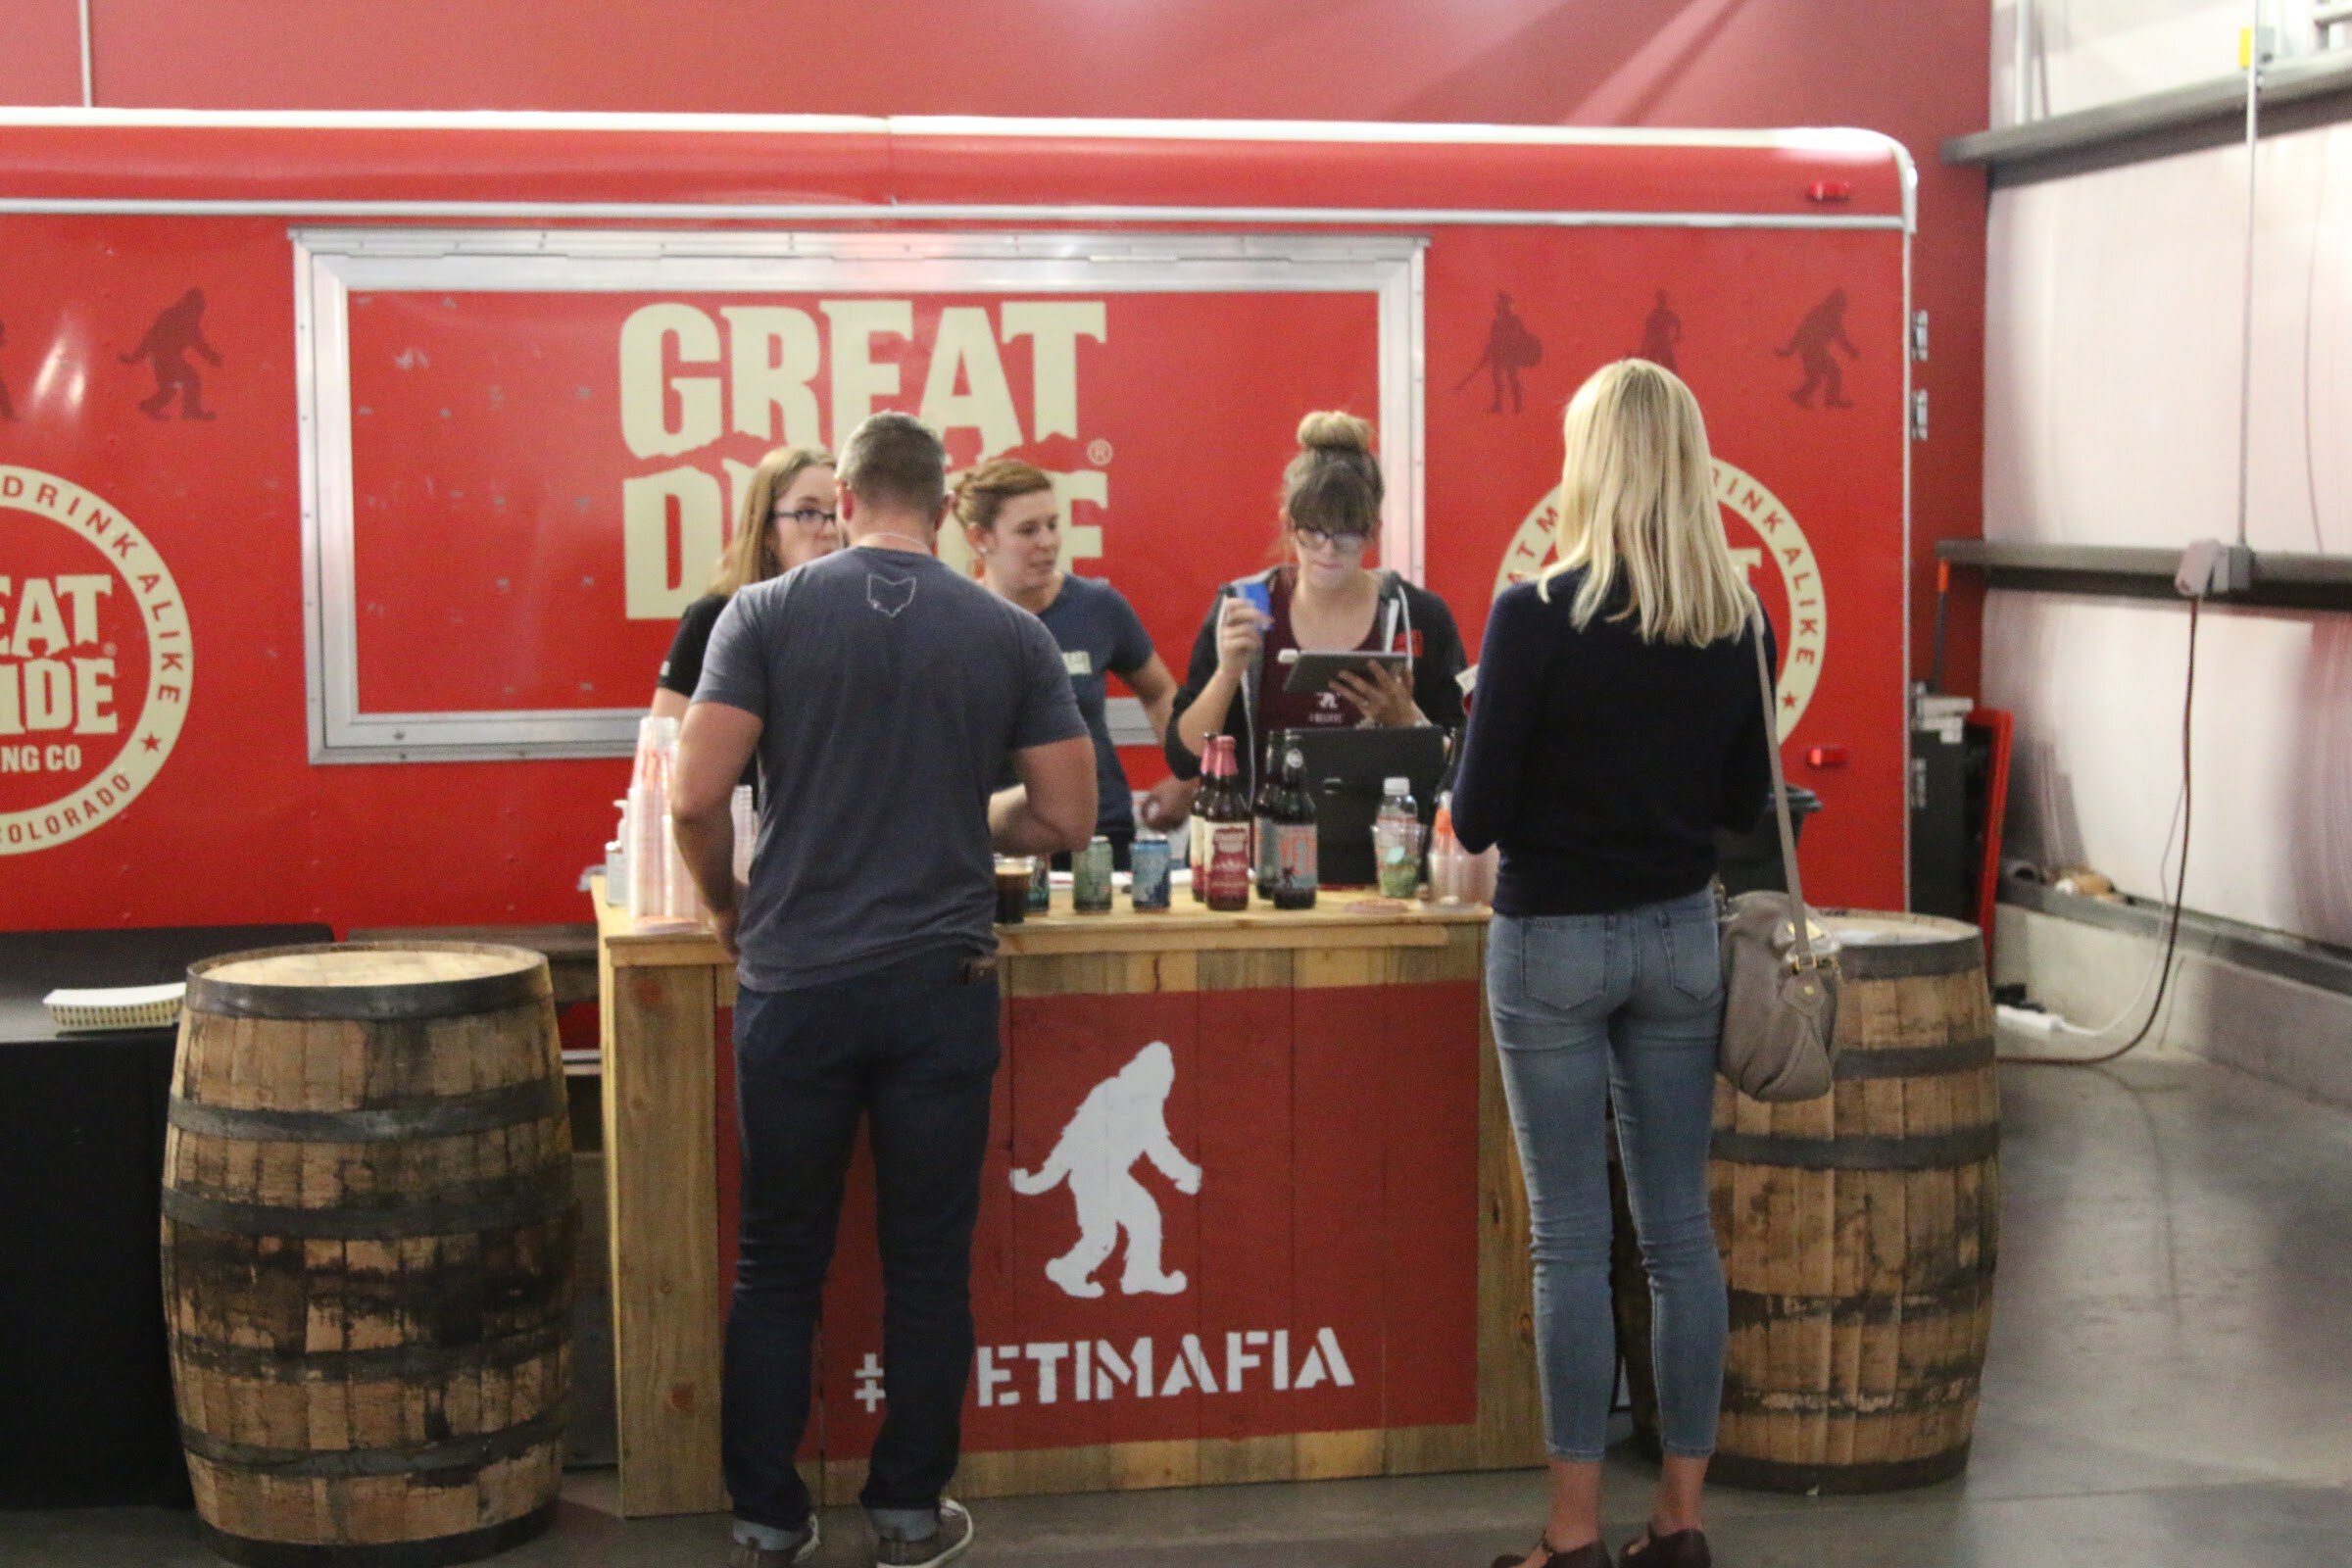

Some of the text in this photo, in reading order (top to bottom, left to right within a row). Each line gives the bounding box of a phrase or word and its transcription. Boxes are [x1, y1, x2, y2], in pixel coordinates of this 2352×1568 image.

[619, 299, 1107, 465] GREAT
[0, 573, 114, 659] AT
[2, 474, 184, 704] DRINK ALIKE
[1781, 547, 1818, 665] ALIKE
[45, 744, 82, 772] CO
[0, 773, 130, 844] OLORADO
[855, 1326, 1355, 1413] #ETIMAFIA
